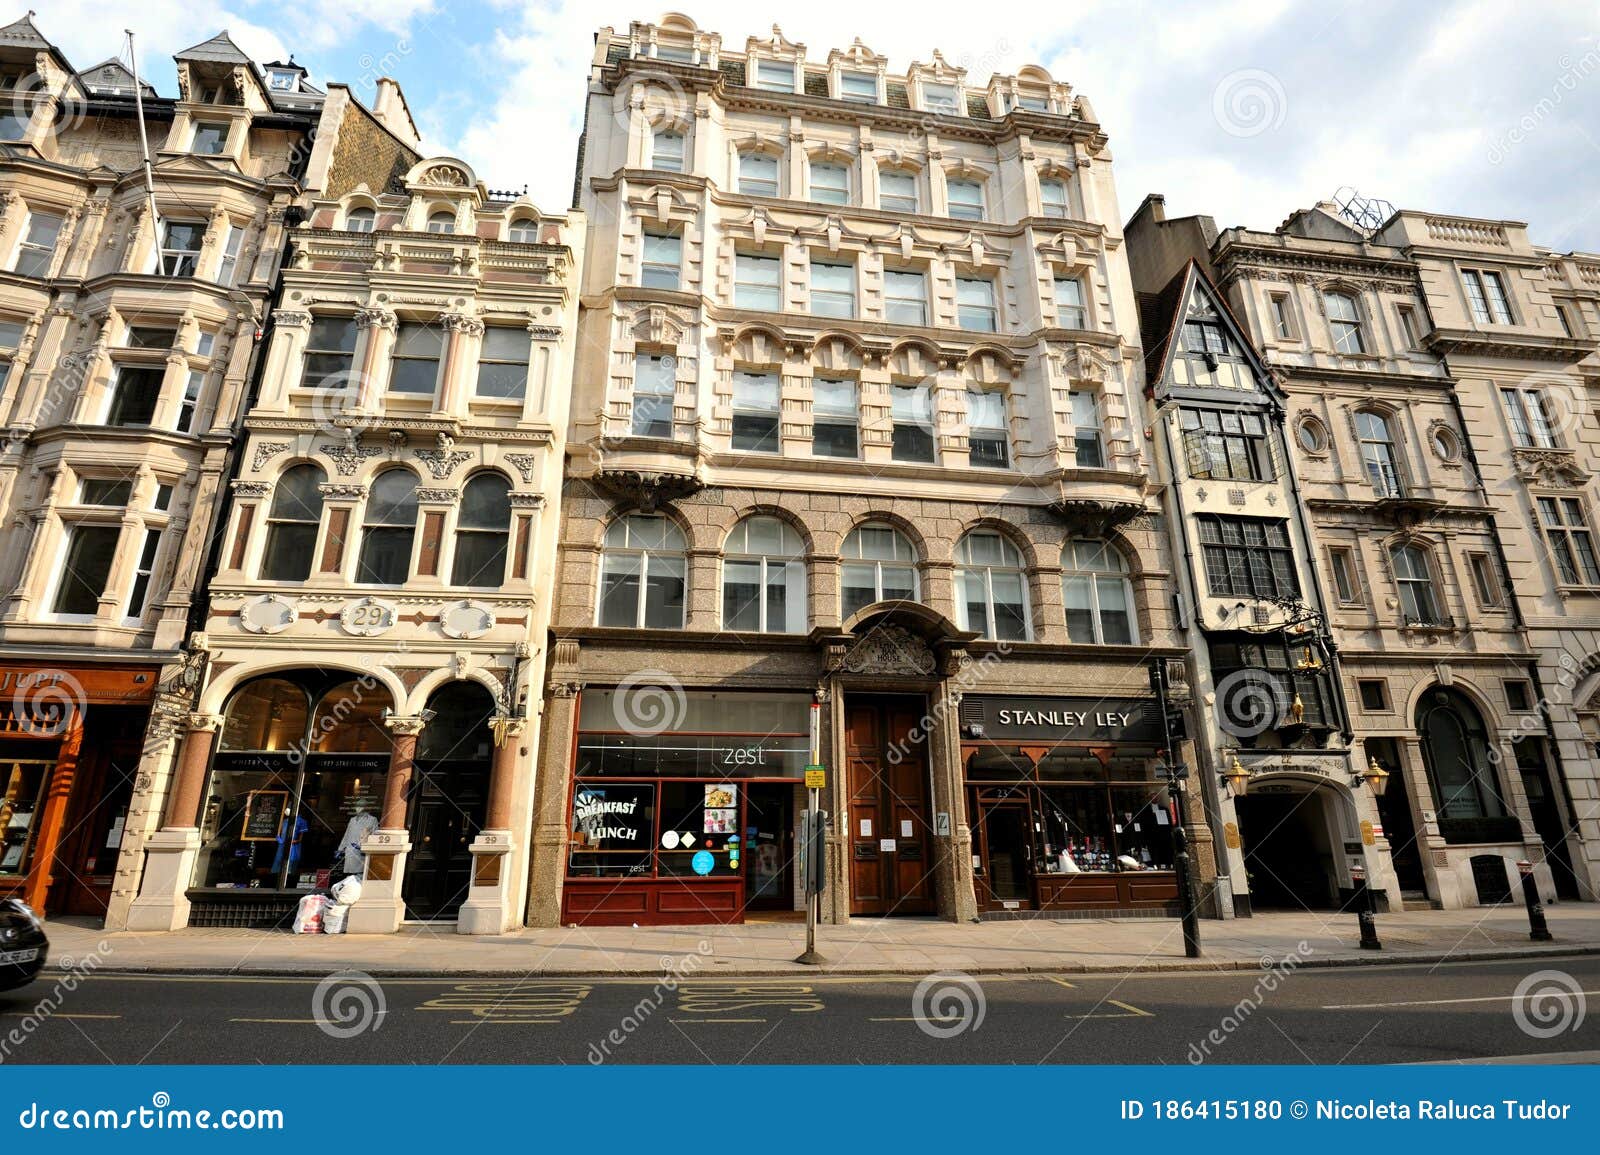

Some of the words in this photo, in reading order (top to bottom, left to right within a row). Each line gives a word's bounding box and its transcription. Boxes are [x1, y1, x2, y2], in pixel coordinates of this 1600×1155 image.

[353, 607, 382, 626] 29
[0, 671, 65, 691] JUPP
[999, 709, 1087, 726] STANLEY
[1095, 711, 1130, 727] LEY
[724, 746, 766, 765] zest
[577, 800, 637, 820] BREAKFAST
[377, 835, 391, 844] 29
[484, 836, 497, 845] 29
[590, 827, 638, 841] LUNCH
[629, 865, 646, 873] zest
